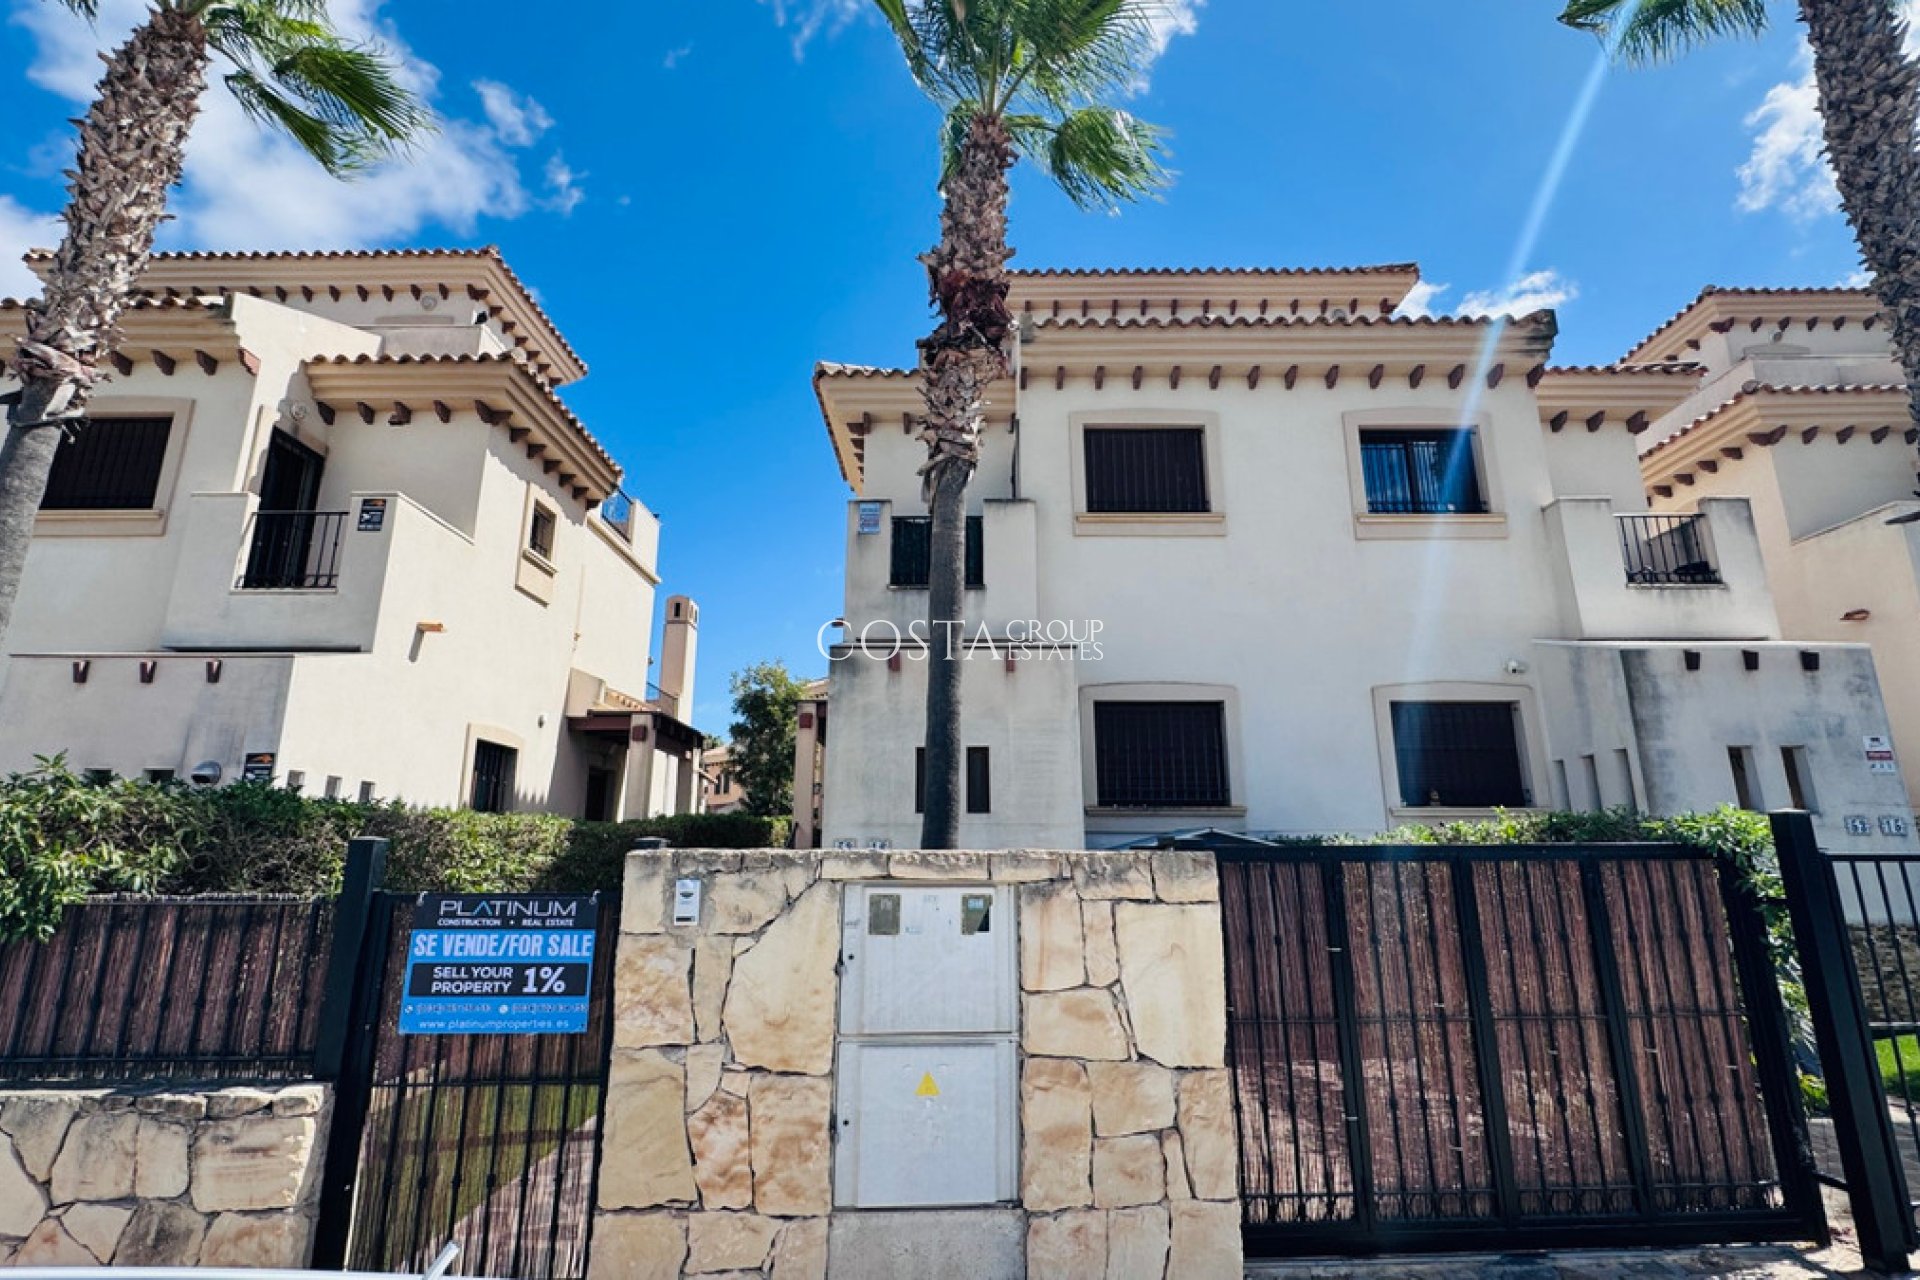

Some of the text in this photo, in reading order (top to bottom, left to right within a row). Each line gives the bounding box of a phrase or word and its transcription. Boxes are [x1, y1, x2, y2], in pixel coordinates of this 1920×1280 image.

[438, 900, 577, 917] PLATINUM
[437, 918, 575, 926] CONSTRUCTION REAL ESTATE
[414, 933, 593, 957] SE VENDE/FOR SALE
[432, 966, 514, 979] SELL YOUR
[522, 966, 567, 994] 1%
[430, 981, 512, 994] PROPERTY
[419, 1018, 569, 1030] www.platinumproperties.es
